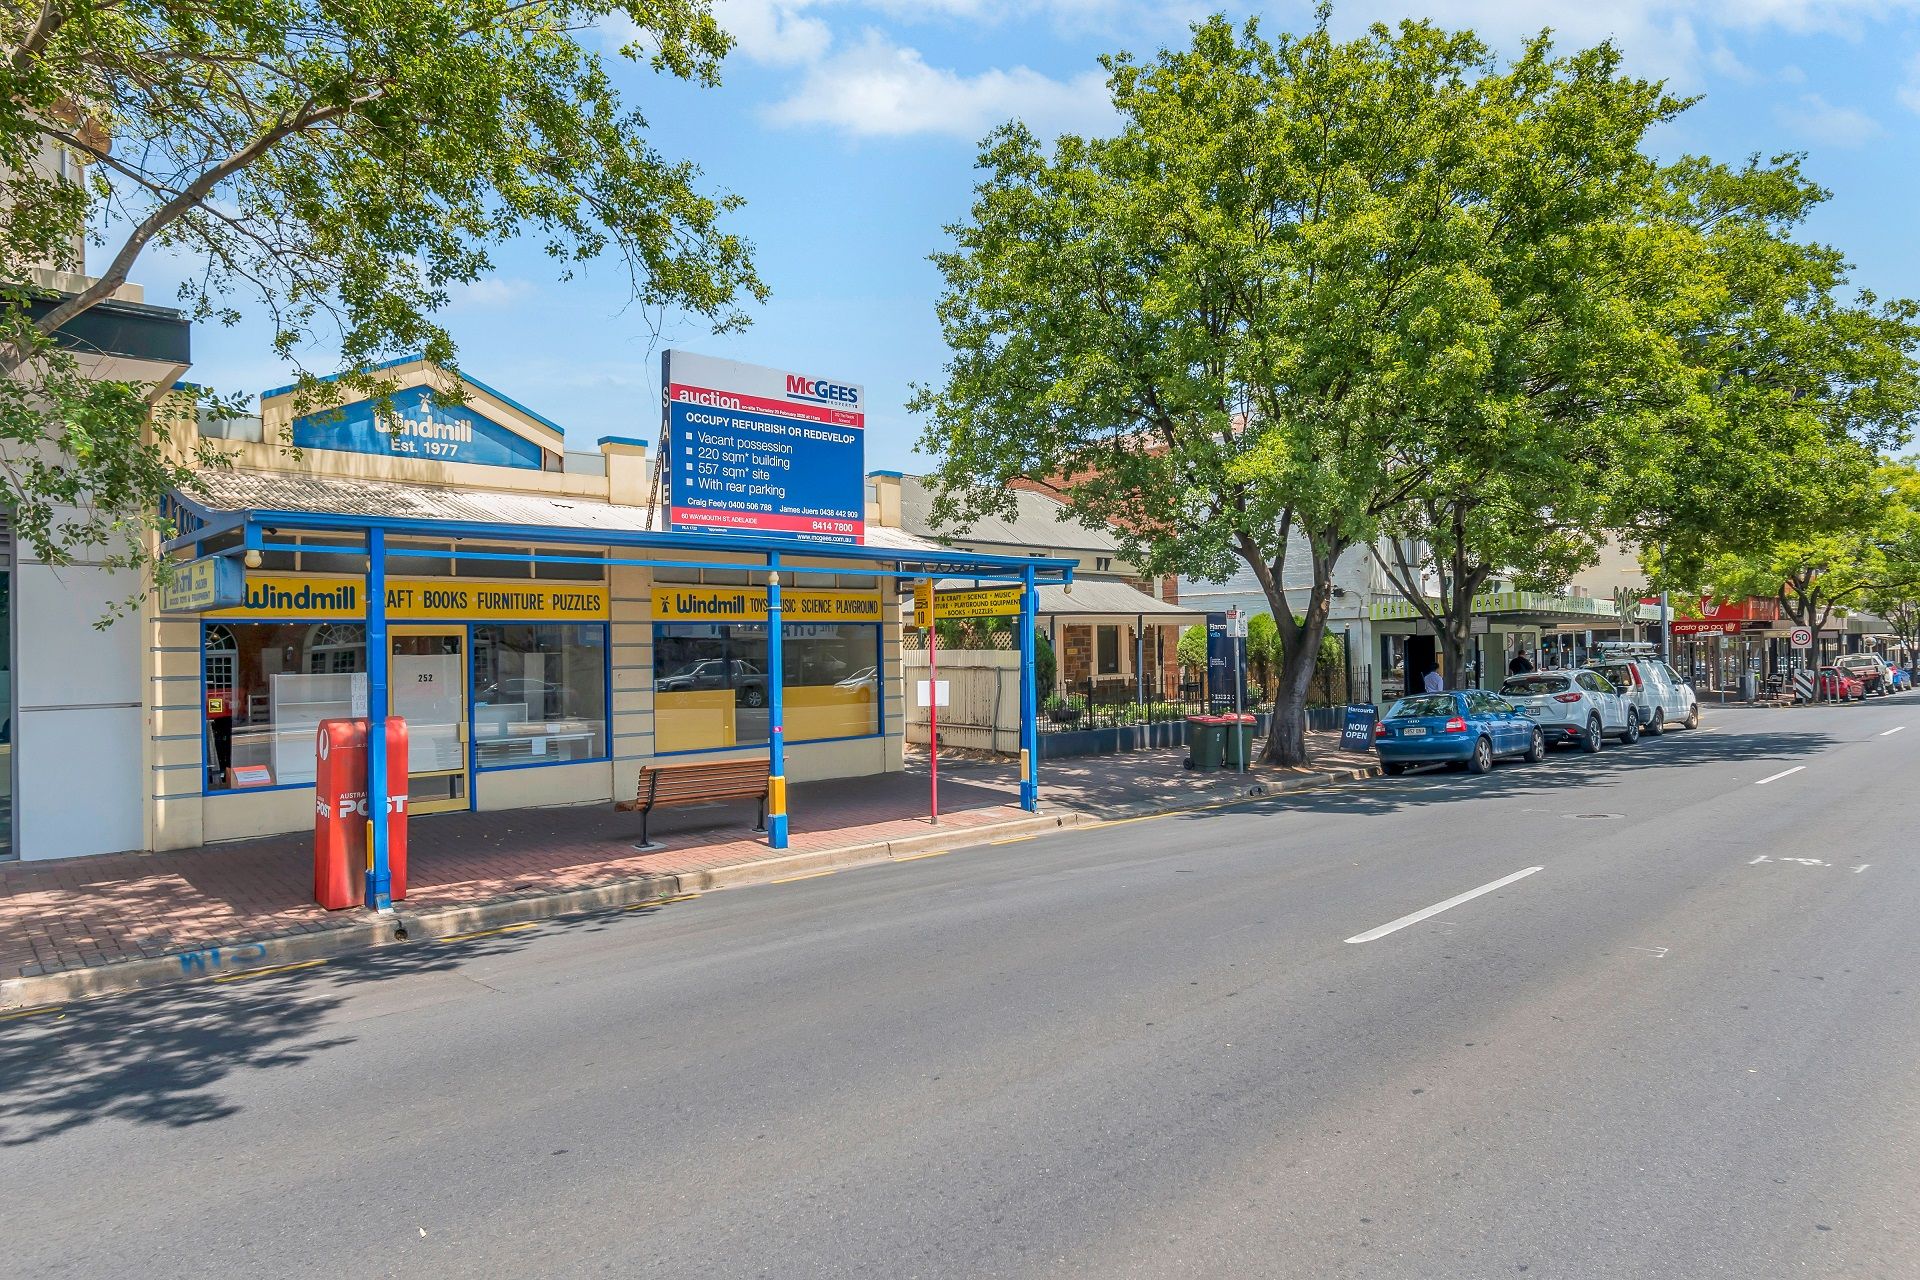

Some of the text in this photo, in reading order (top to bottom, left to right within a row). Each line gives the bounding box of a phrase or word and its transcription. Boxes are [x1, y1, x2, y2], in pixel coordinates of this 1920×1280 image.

[680, 389, 740, 410] auction
[686, 412, 855, 444] OCCUPY REFURBISH OR REDEVELOP
[391, 438, 458, 456] Est. 1977
[698, 431, 792, 454] Vacant possession
[699, 447, 719, 460] 220
[752, 455, 790, 470] building
[699, 463, 718, 475] 557
[752, 469, 769, 480] site
[698, 477, 785, 498] With rear parking
[687, 498, 772, 511] Craig Feely 0400 506 788
[780, 505, 800, 514] James
[820, 507, 834, 516] 0438
[836, 509, 847, 518] 442
[689, 513, 721, 522] WAYMOUTH
[731, 516, 757, 524] ADELAIDE
[812, 521, 853, 532] 8414 7800
[245, 584, 355, 609] Windmill
[423, 591, 467, 609] BOOKS
[477, 592, 544, 610] FURNITURE
[552, 594, 600, 611] PUZZLES
[676, 593, 878, 614] Windmill TOYS USIC SCIENCE PLAYGROUND
[1476, 598, 1500, 608] BAR
[918, 612, 924, 624] 10
[1795, 634, 1808, 642] 50
[418, 674, 433, 682] 252
[1349, 723, 1368, 731] NOW
[1346, 731, 1367, 739] OPEN
[317, 801, 330, 818] POST
